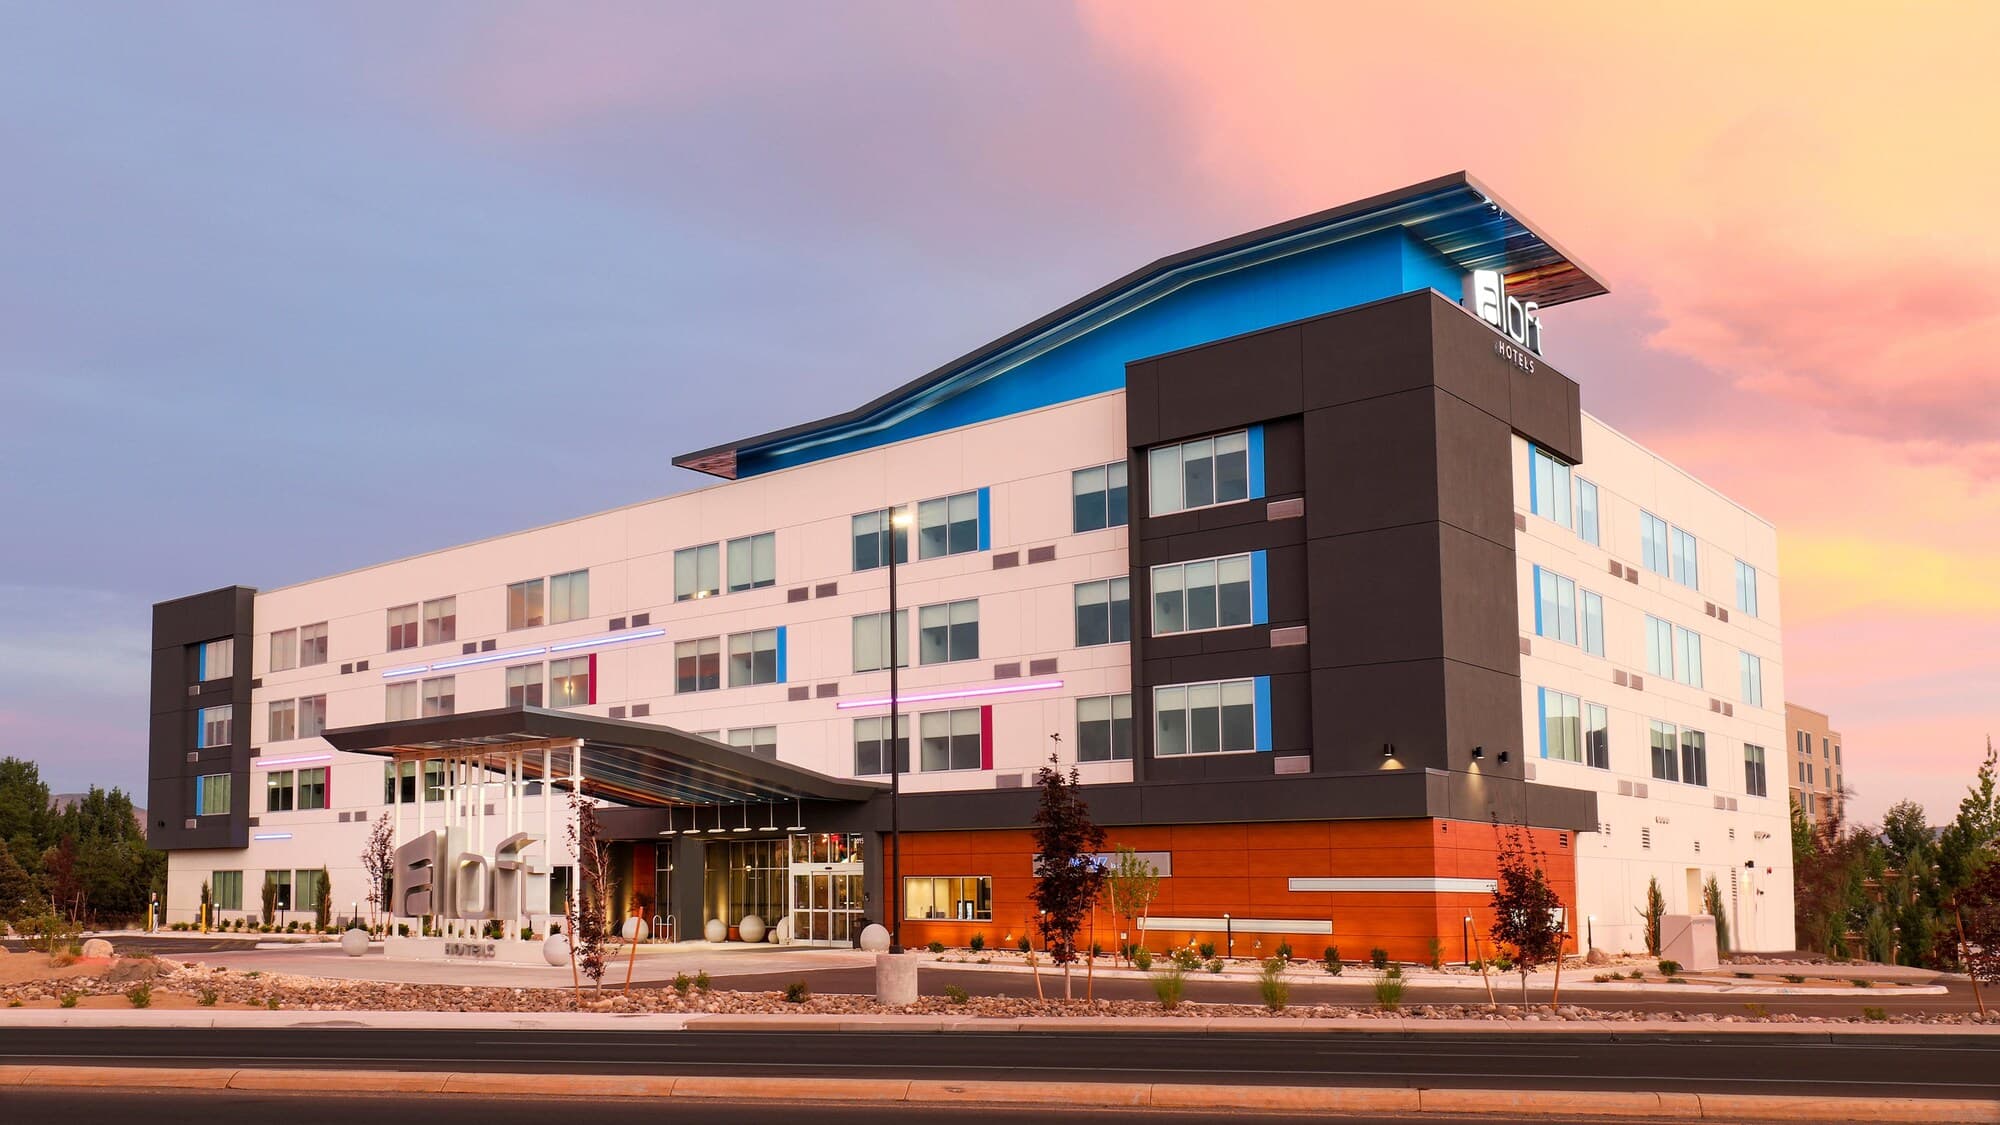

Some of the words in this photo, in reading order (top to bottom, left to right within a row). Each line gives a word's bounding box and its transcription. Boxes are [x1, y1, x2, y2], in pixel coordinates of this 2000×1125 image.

[1474, 269, 1543, 356] aloft
[1499, 340, 1535, 374] HOTELS
[444, 943, 496, 958] HOTELS
